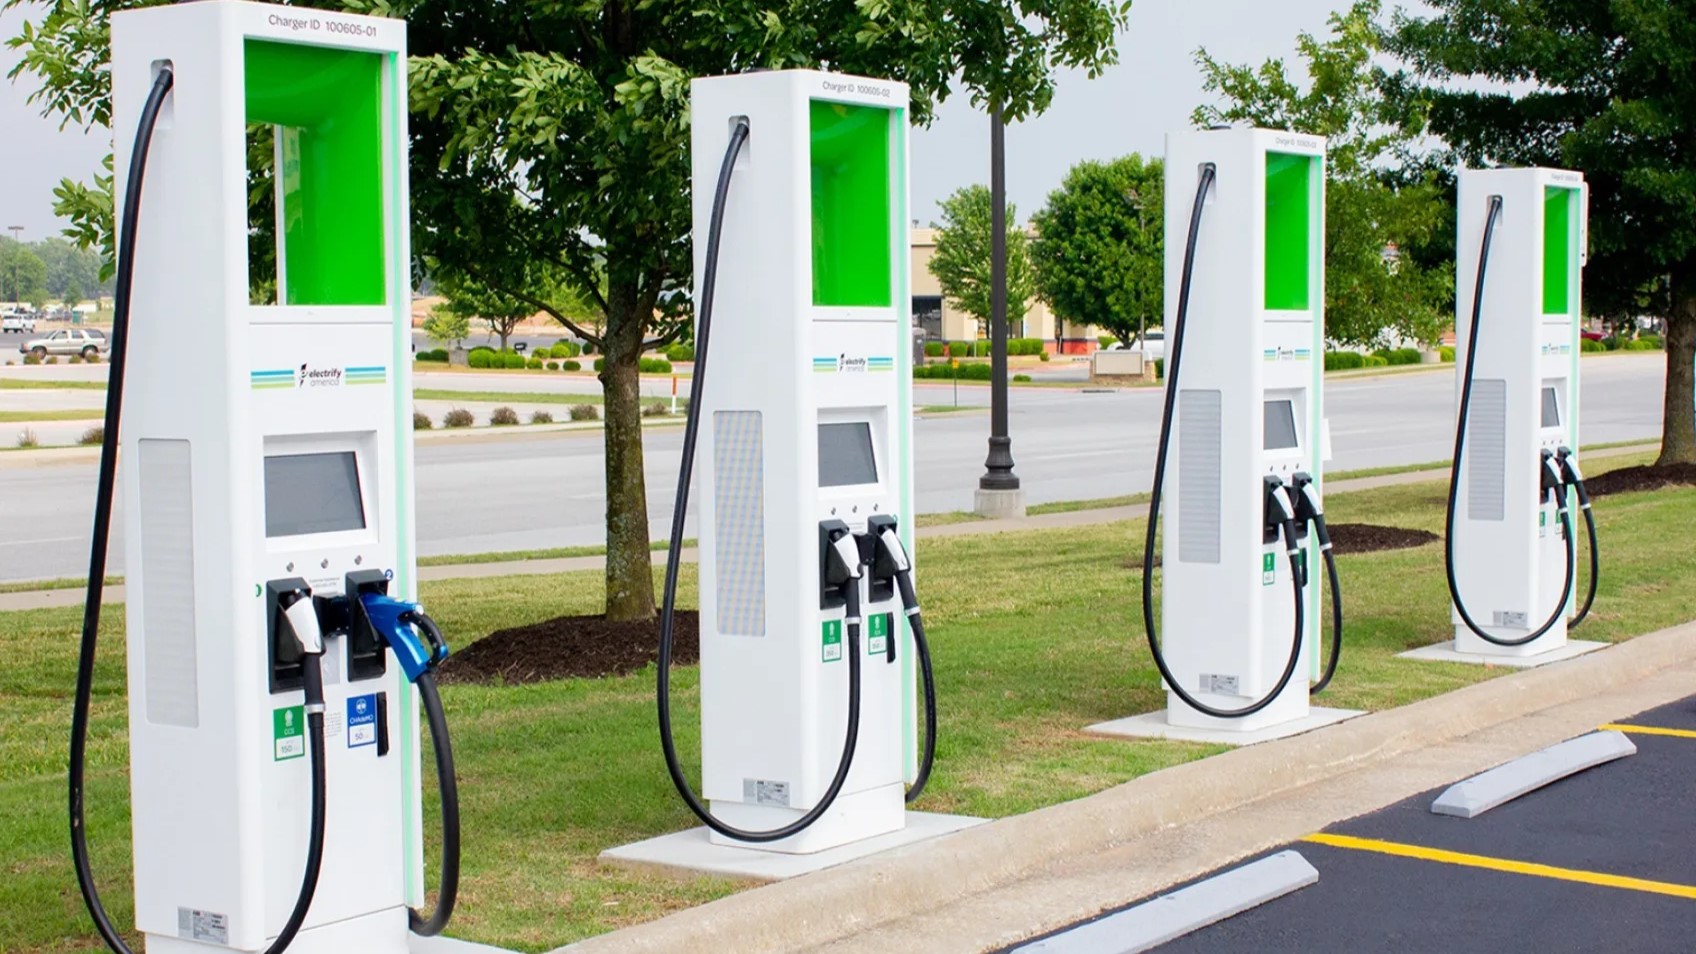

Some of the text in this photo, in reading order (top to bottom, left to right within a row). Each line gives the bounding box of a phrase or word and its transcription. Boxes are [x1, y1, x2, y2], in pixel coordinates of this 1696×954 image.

[268, 14, 377, 37] Charger ID 100605-01
[822, 81, 847, 94] Charger
[847, 84, 855, 93] ID
[309, 368, 342, 380] electrify
[310, 378, 340, 387] america
